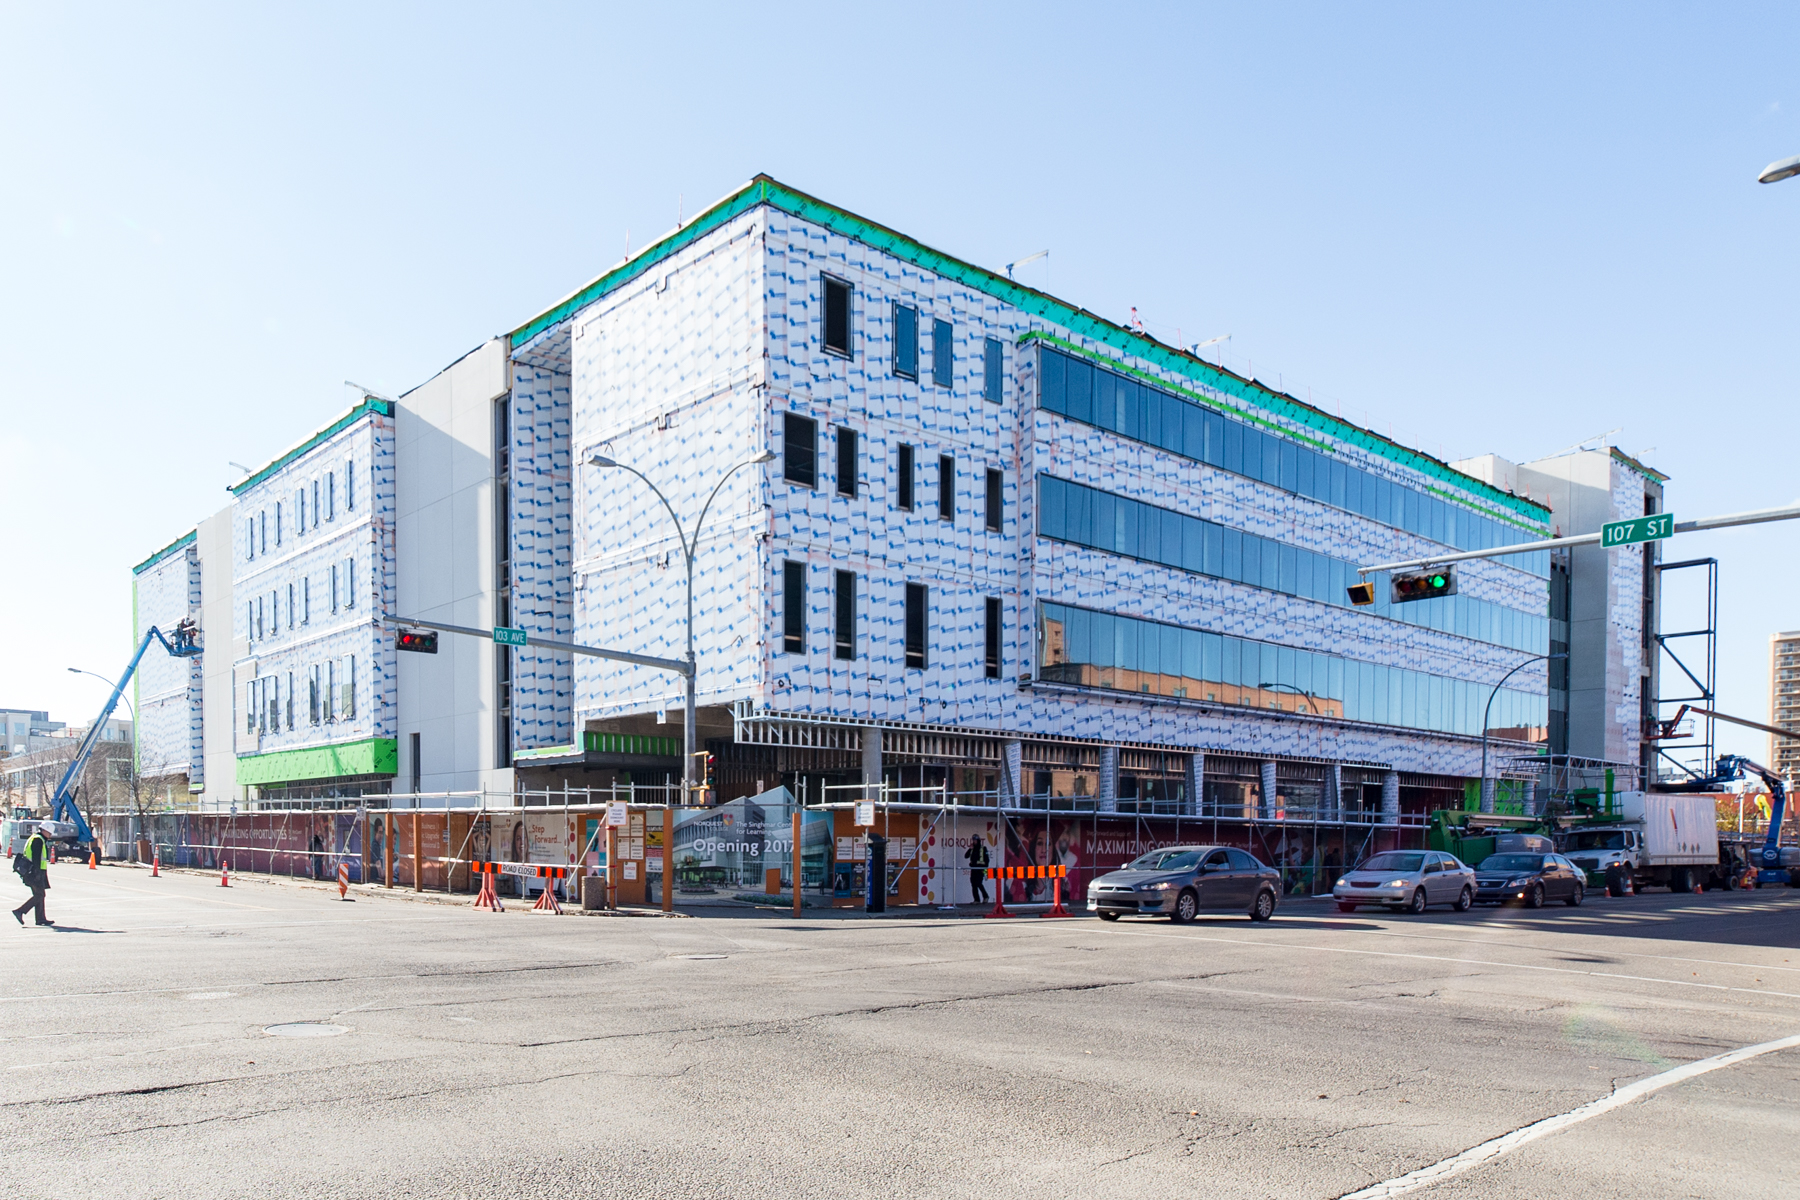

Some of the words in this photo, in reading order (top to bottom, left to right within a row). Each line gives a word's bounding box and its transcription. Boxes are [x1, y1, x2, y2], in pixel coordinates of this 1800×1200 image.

[1608, 524, 1634, 542] 107
[1647, 518, 1667, 536] ST
[496, 630, 508, 641] 103
[511, 632, 524, 643] AVE
[748, 822, 776, 830] Singhmar
[693, 838, 759, 856] Opening
[764, 840, 793, 853] 2017
[941, 838, 985, 848] NORQUT
[1086, 840, 1154, 854] MAXIMIZNG
[1158, 840, 1231, 848] OPPORTUNTIES
[503, 865, 517, 873] ROAD
[518, 867, 536, 876] CLOSED
